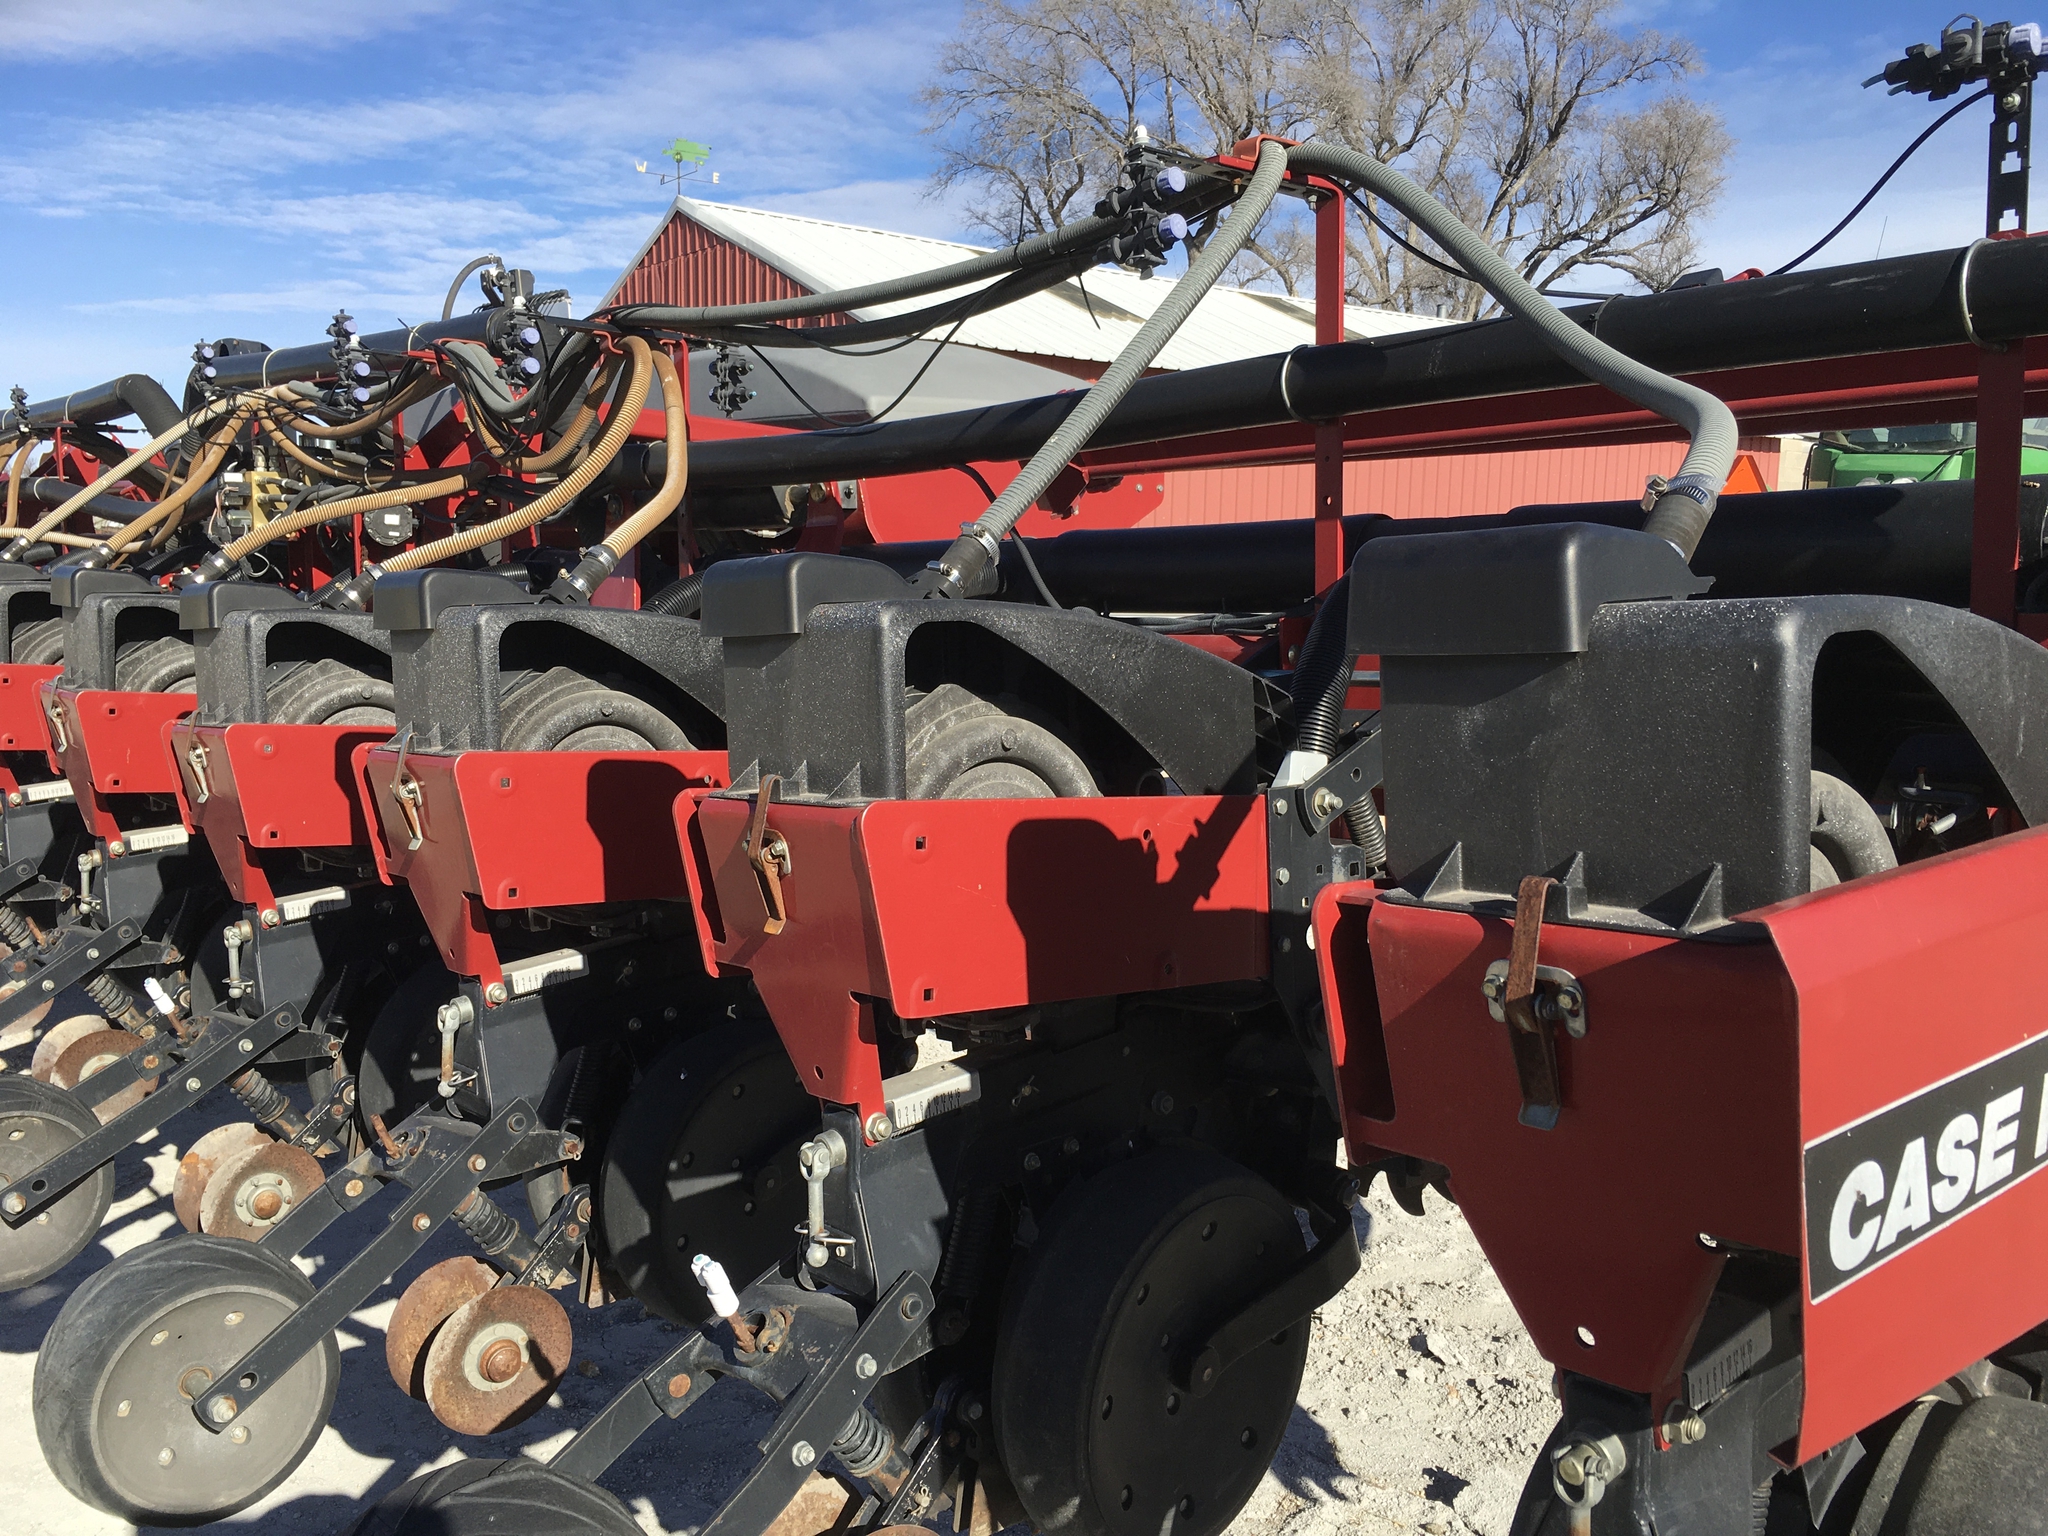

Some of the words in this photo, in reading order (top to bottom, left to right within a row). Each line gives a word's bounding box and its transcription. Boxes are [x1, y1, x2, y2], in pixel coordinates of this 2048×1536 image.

[634, 160, 648, 173] W
[712, 171, 721, 184] E
[1829, 1086, 2024, 1271] CASE
